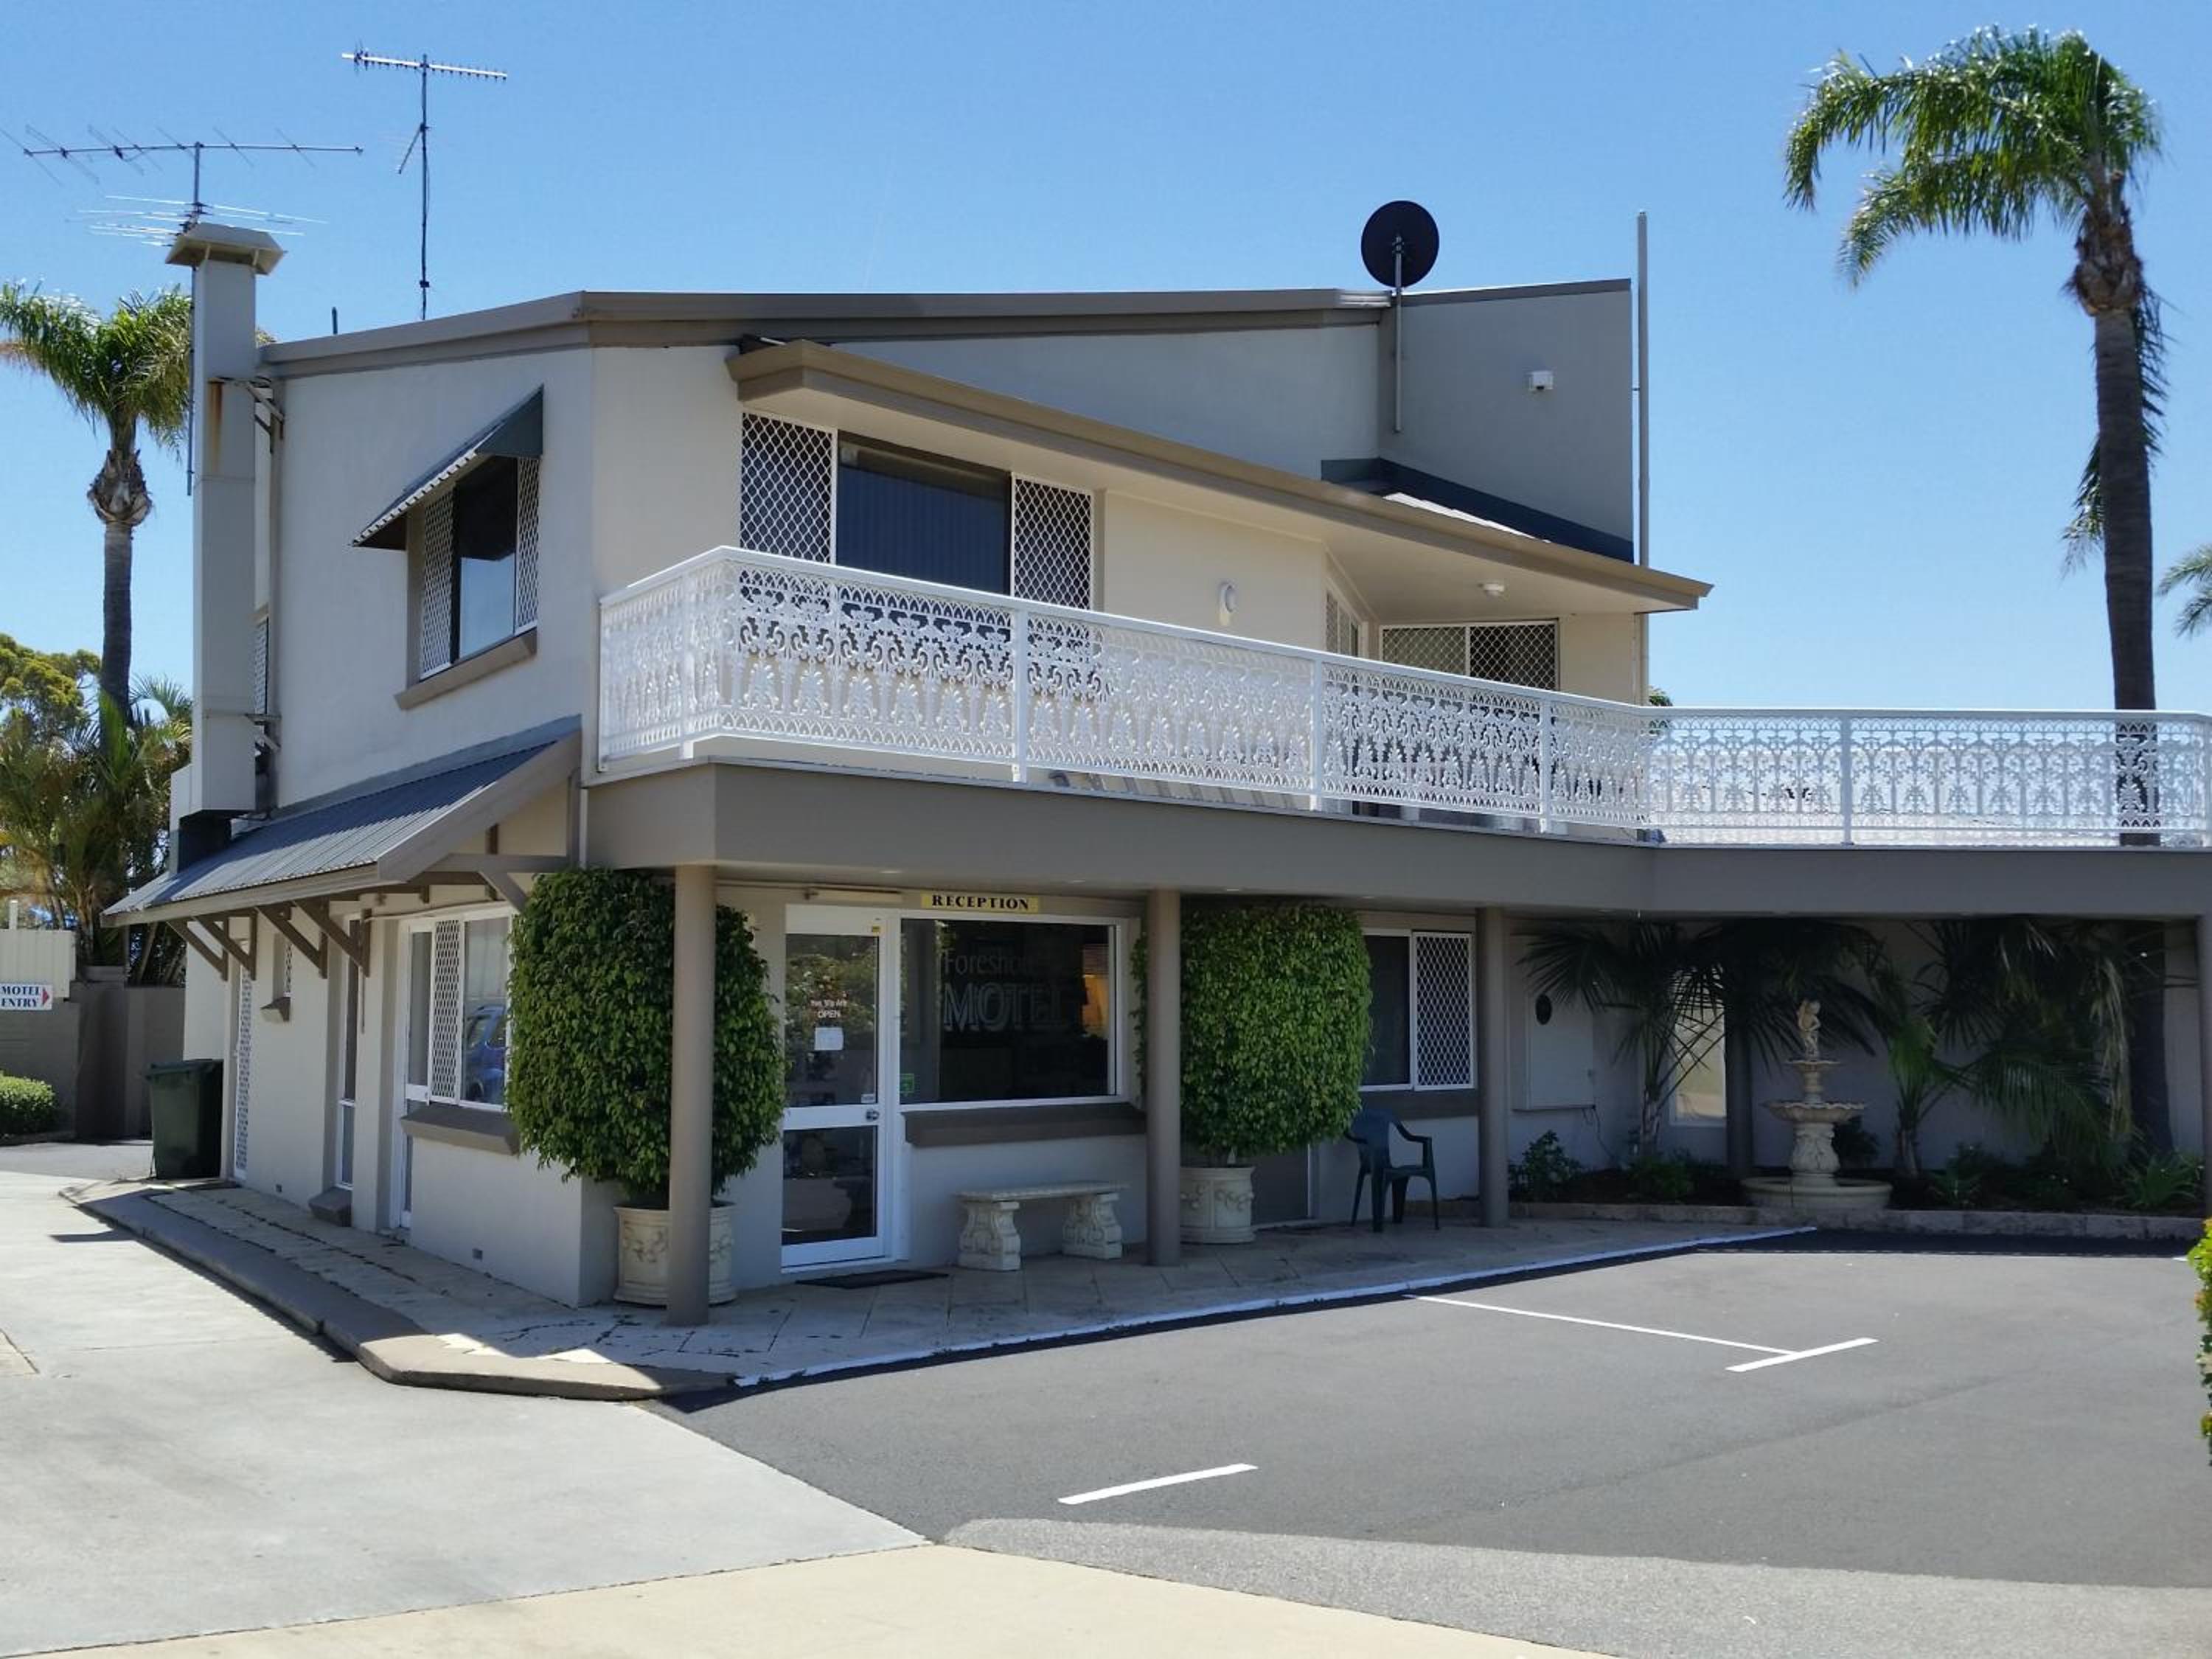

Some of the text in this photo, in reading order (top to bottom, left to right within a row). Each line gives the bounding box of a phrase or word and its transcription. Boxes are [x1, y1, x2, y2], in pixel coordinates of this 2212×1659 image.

[932, 894, 1029, 910] RECEPTION
[1, 986, 40, 995] MOTEL
[1, 998, 39, 1007] ENTRY
[943, 981, 1067, 1032] MOTEL
[817, 1009, 841, 1018] OPEN
